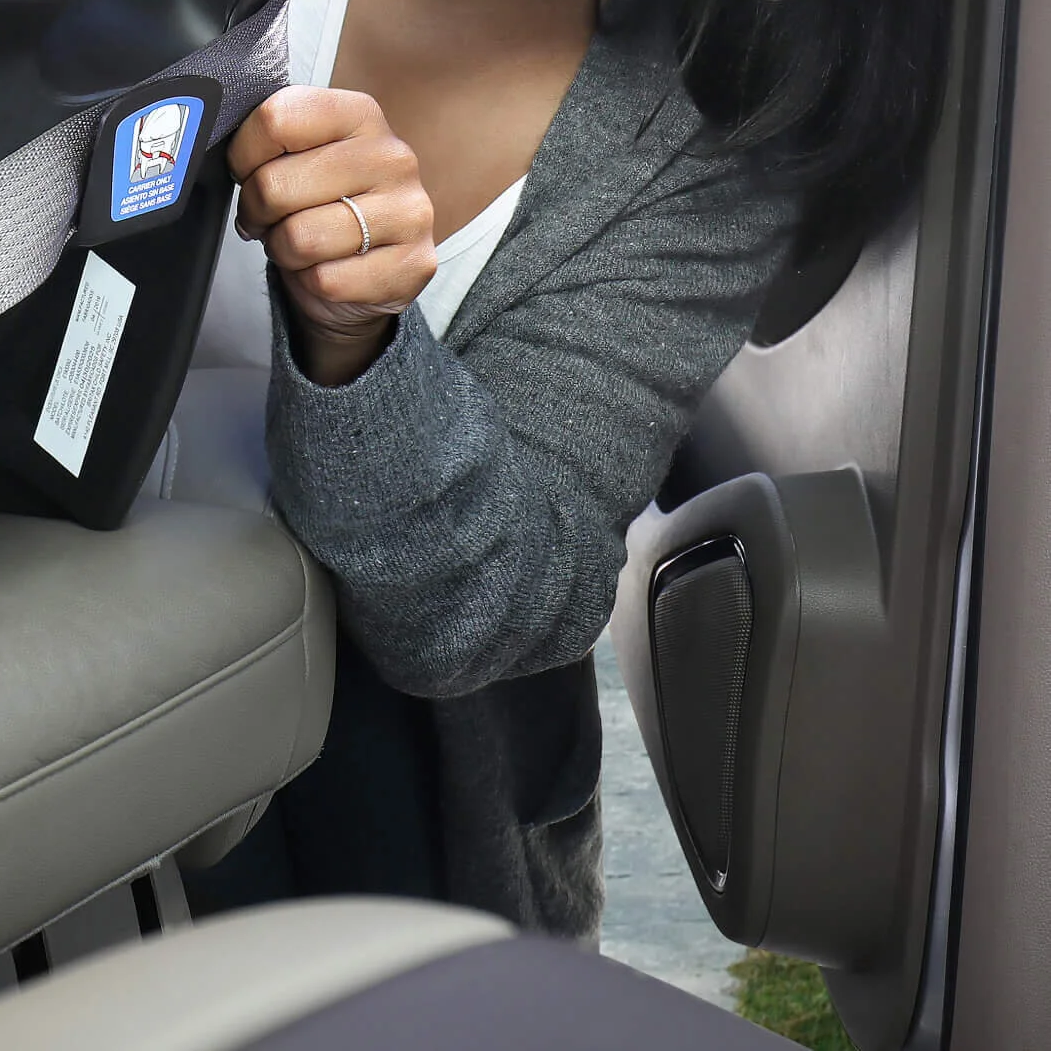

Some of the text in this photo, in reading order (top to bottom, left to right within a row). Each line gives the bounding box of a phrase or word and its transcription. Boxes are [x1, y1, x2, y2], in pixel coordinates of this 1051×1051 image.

[128, 175, 172, 194] CARRIER ONLY
[121, 183, 175, 206] ASIENTO SIN BASE
[139, 199, 156, 209] SANS
[156, 193, 172, 203] BASE
